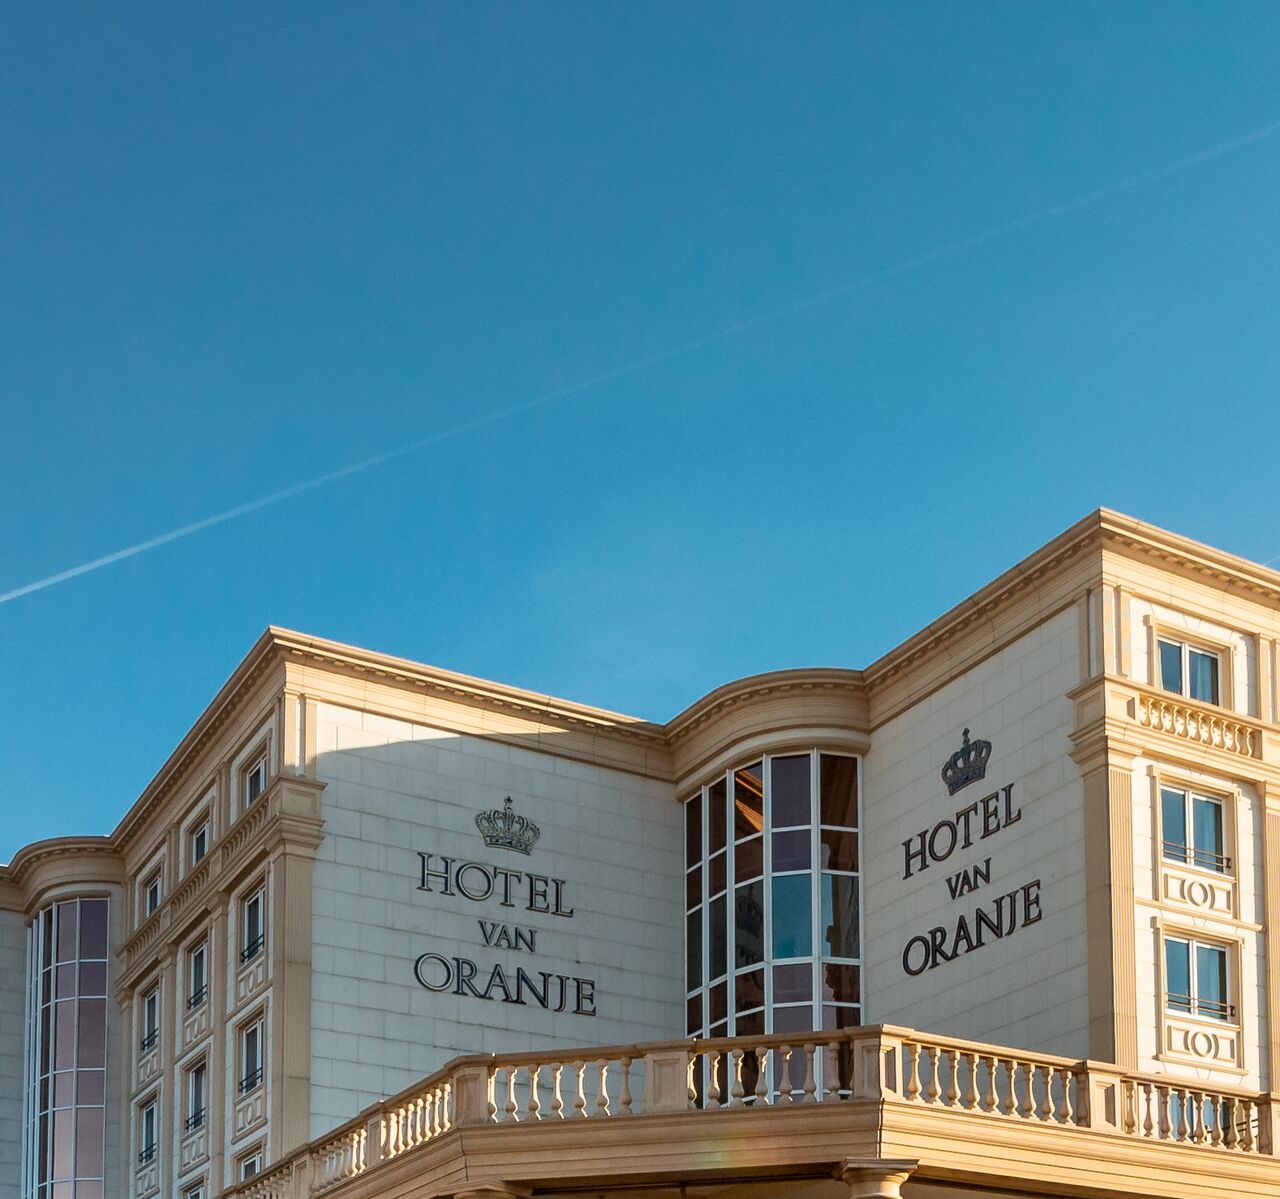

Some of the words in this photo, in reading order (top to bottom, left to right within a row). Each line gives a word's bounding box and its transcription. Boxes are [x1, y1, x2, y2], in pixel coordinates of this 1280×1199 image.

[901, 783, 1021, 880] HOTEL
[416, 852, 574, 918] HOTEL
[945, 857, 992, 900] VAN
[477, 920, 538, 953] VAN
[902, 879, 1043, 976] ORANJE
[414, 953, 597, 1017] ORANJE
